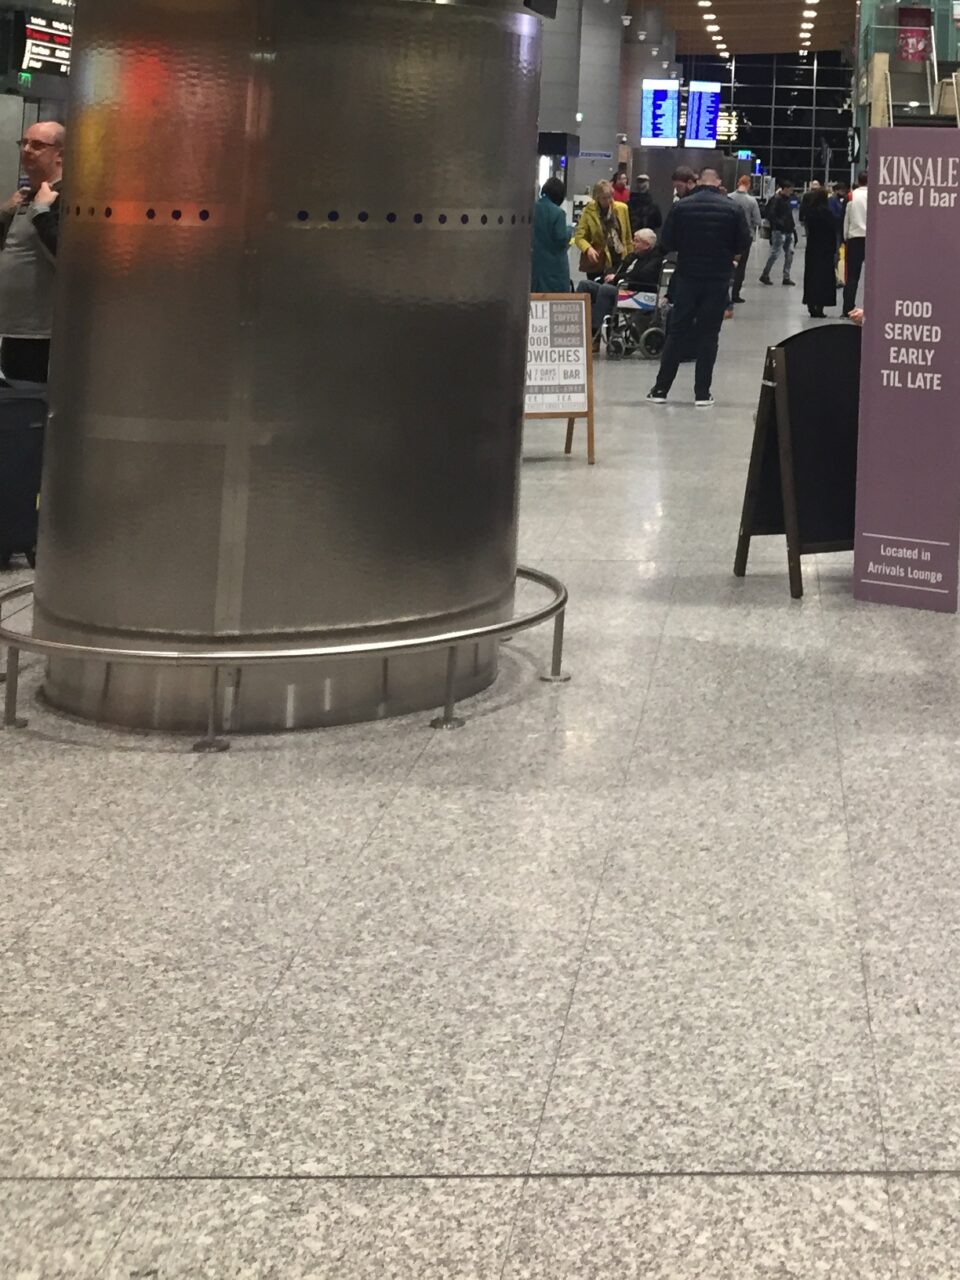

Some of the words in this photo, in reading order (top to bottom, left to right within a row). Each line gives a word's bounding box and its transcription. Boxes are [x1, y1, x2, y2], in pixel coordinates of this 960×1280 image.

[878, 156, 960, 187] KINSALE
[878, 187, 914, 206] cafe
[930, 189, 958, 208] bar
[894, 300, 933, 318] FOOD
[531, 323, 548, 334] bar
[884, 323, 942, 342] SERVED
[530, 336, 549, 347] OOD
[889, 347, 935, 366] EARLY
[563, 369, 580, 380] BAR
[881, 370, 902, 387] TIL
[907, 372, 942, 391] LATE
[880, 544, 919, 560] Located
[921, 548, 932, 561] in
[867, 561, 905, 577] Arrivals
[907, 566, 943, 584] Lounge
